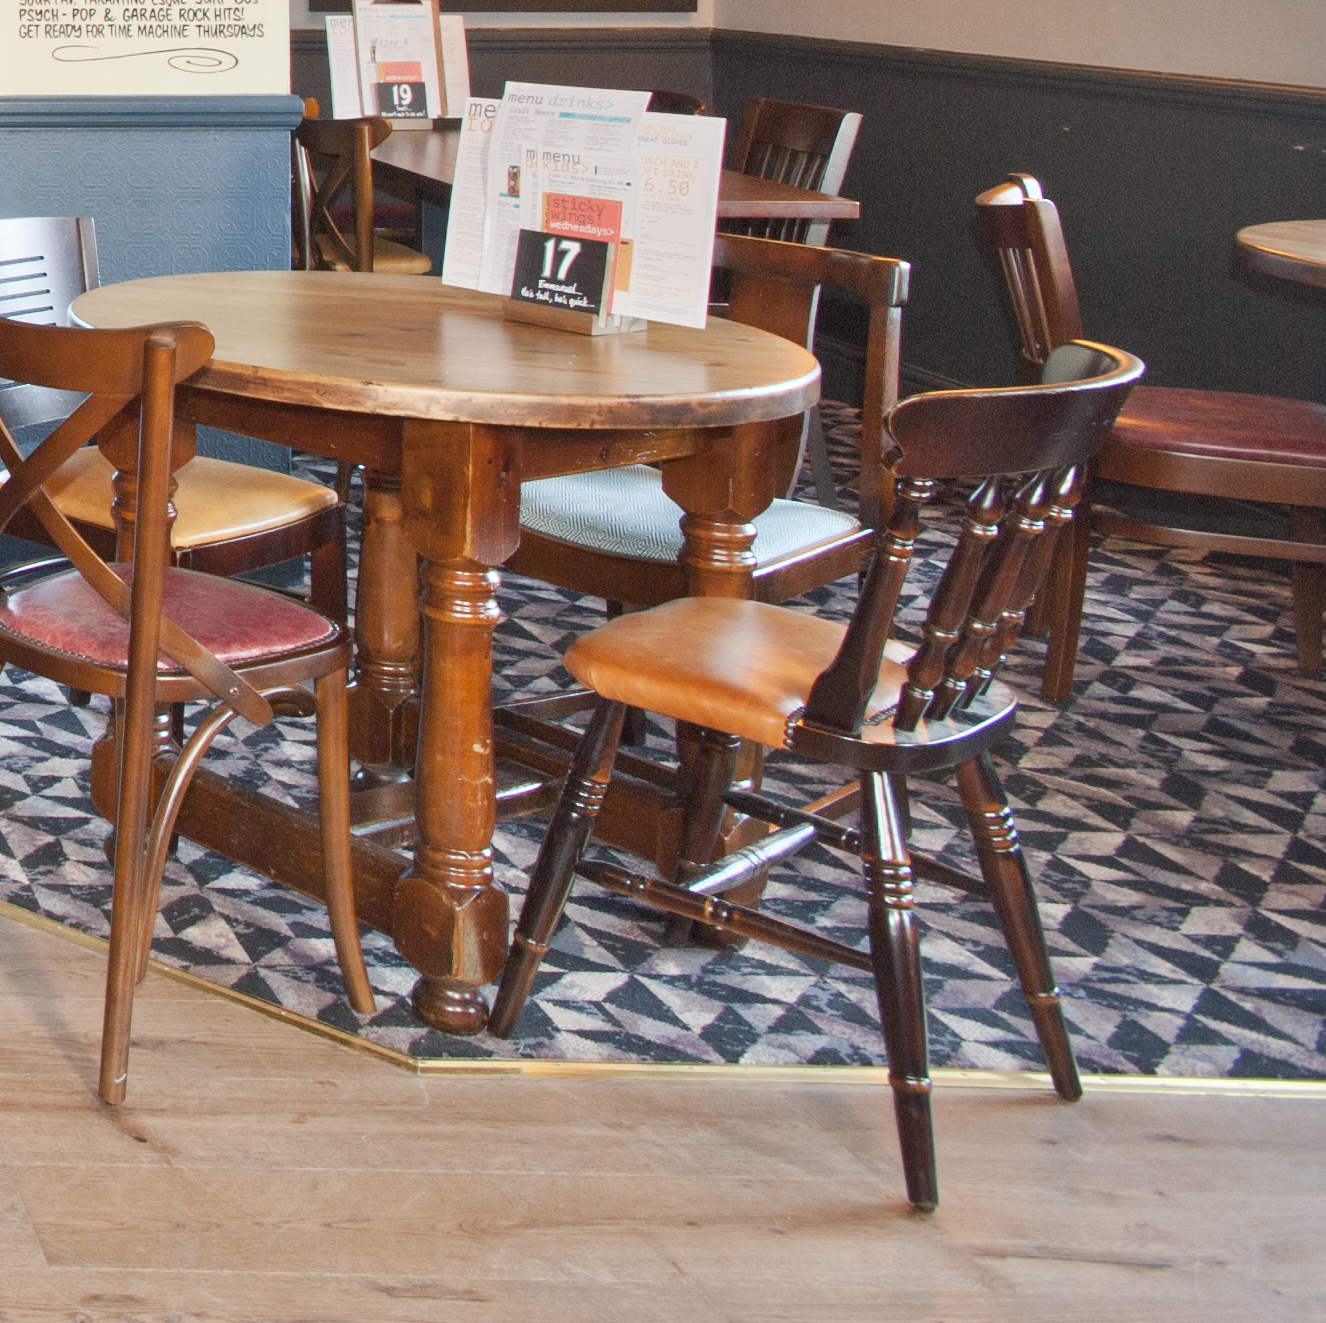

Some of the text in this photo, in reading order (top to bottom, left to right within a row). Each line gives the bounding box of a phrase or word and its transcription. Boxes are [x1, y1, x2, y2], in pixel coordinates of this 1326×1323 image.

[19, 23, 264, 38] GET READY FOR TIME MACHINE THURSDAYS
[392, 84, 412, 105] 19
[507, 93, 543, 104] menu
[543, 151, 580, 164] menu
[552, 198, 605, 215] sticky
[541, 237, 582, 281] 17
